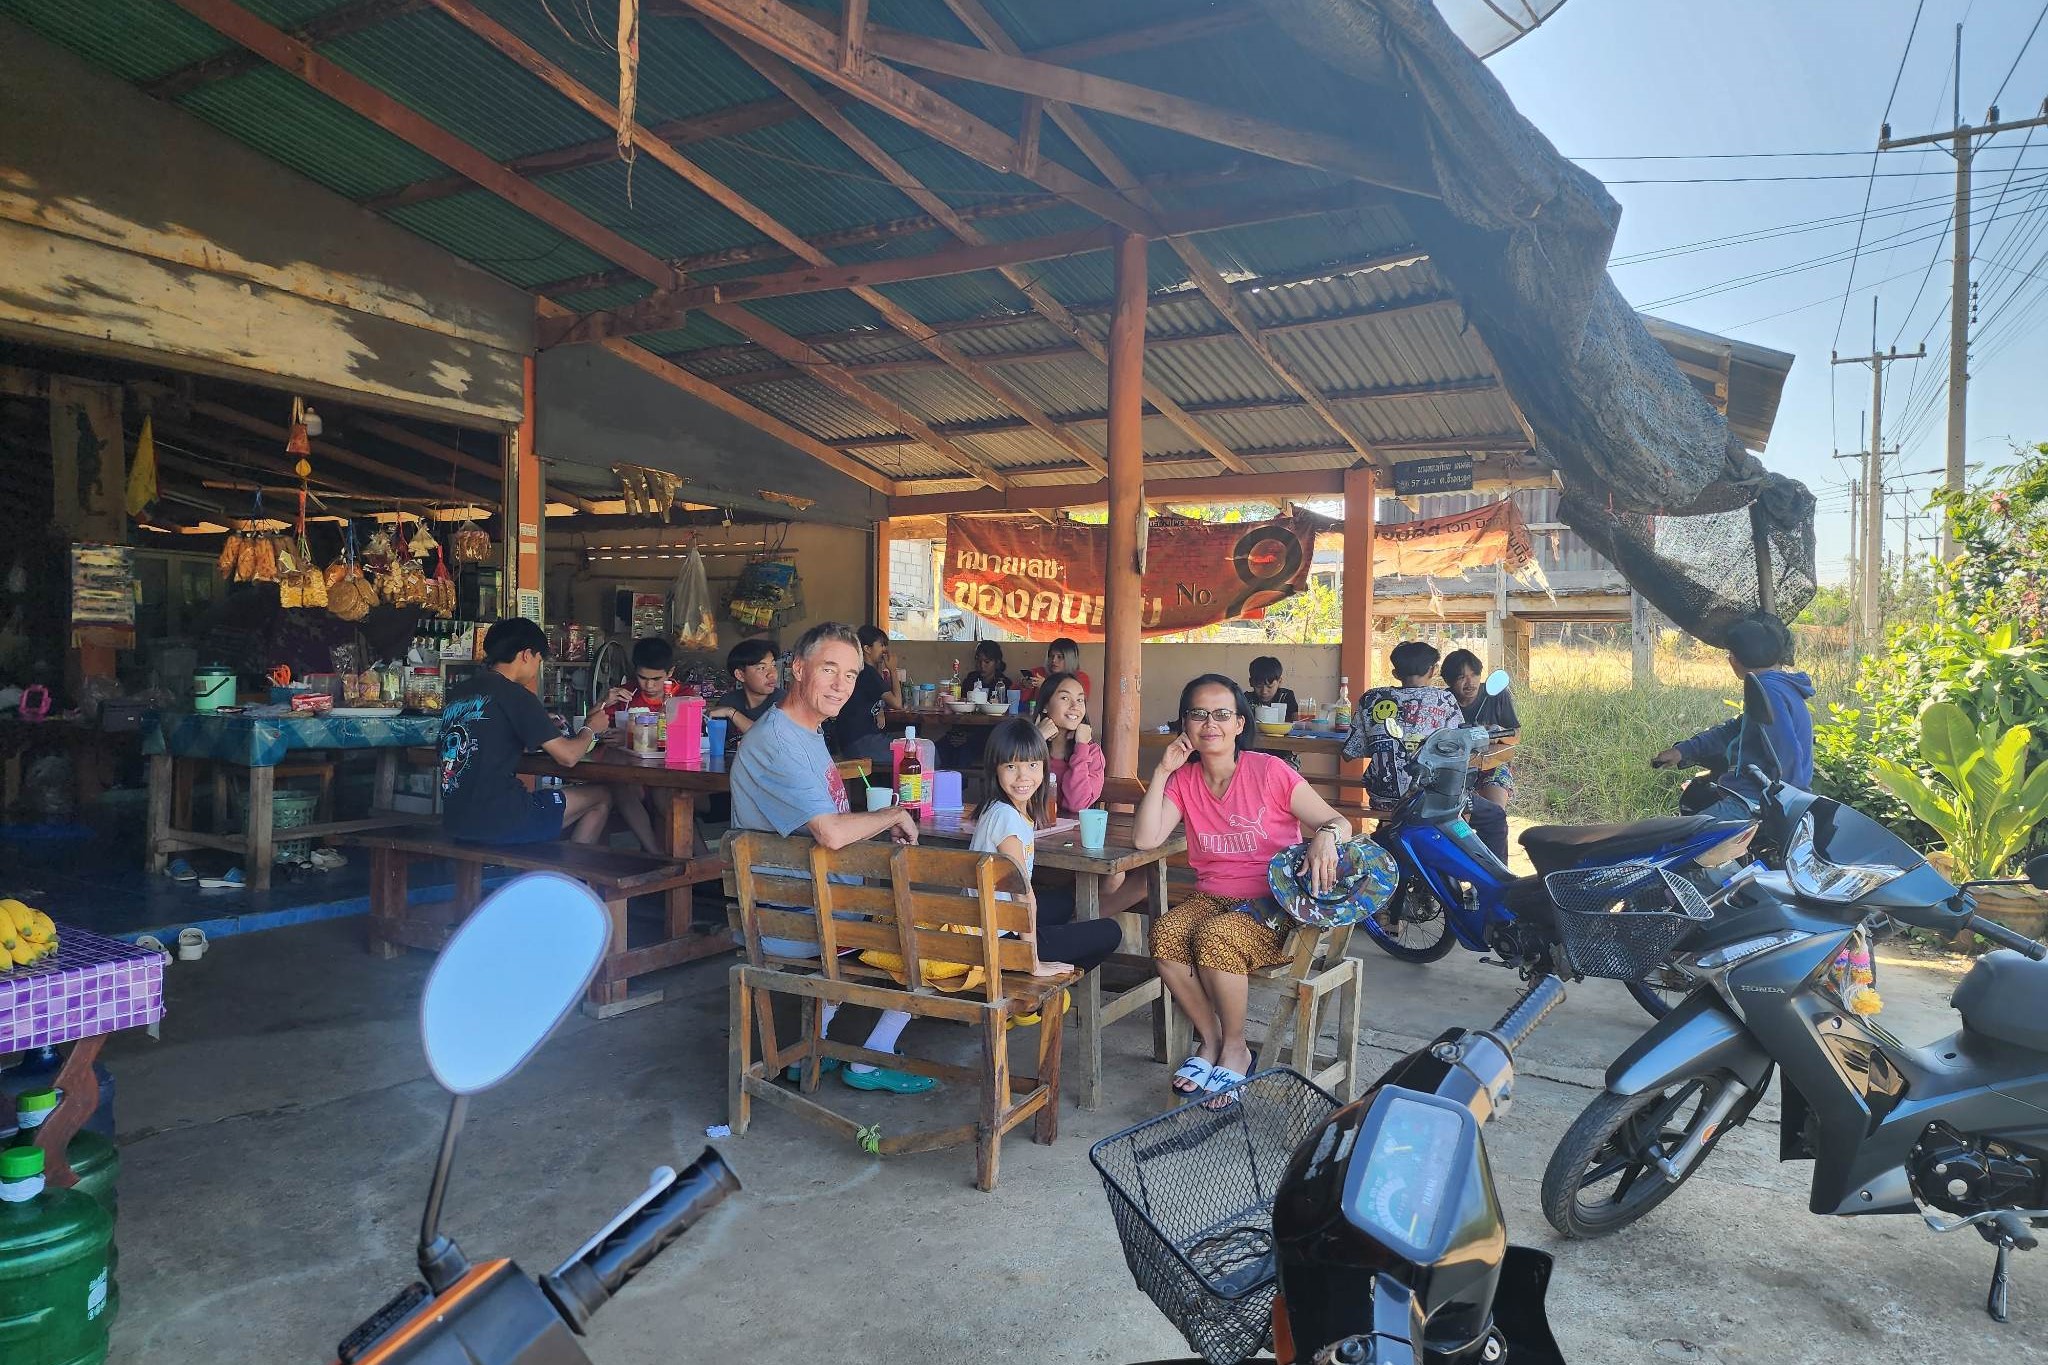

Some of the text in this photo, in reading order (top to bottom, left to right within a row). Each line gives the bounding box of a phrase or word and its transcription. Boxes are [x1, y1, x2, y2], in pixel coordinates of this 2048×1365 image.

[957, 549, 1058, 580] หมายเลข
[1176, 579, 1217, 607] No.
[1199, 831, 1257, 854] PUMA
[1740, 985, 1786, 994] HONDA
